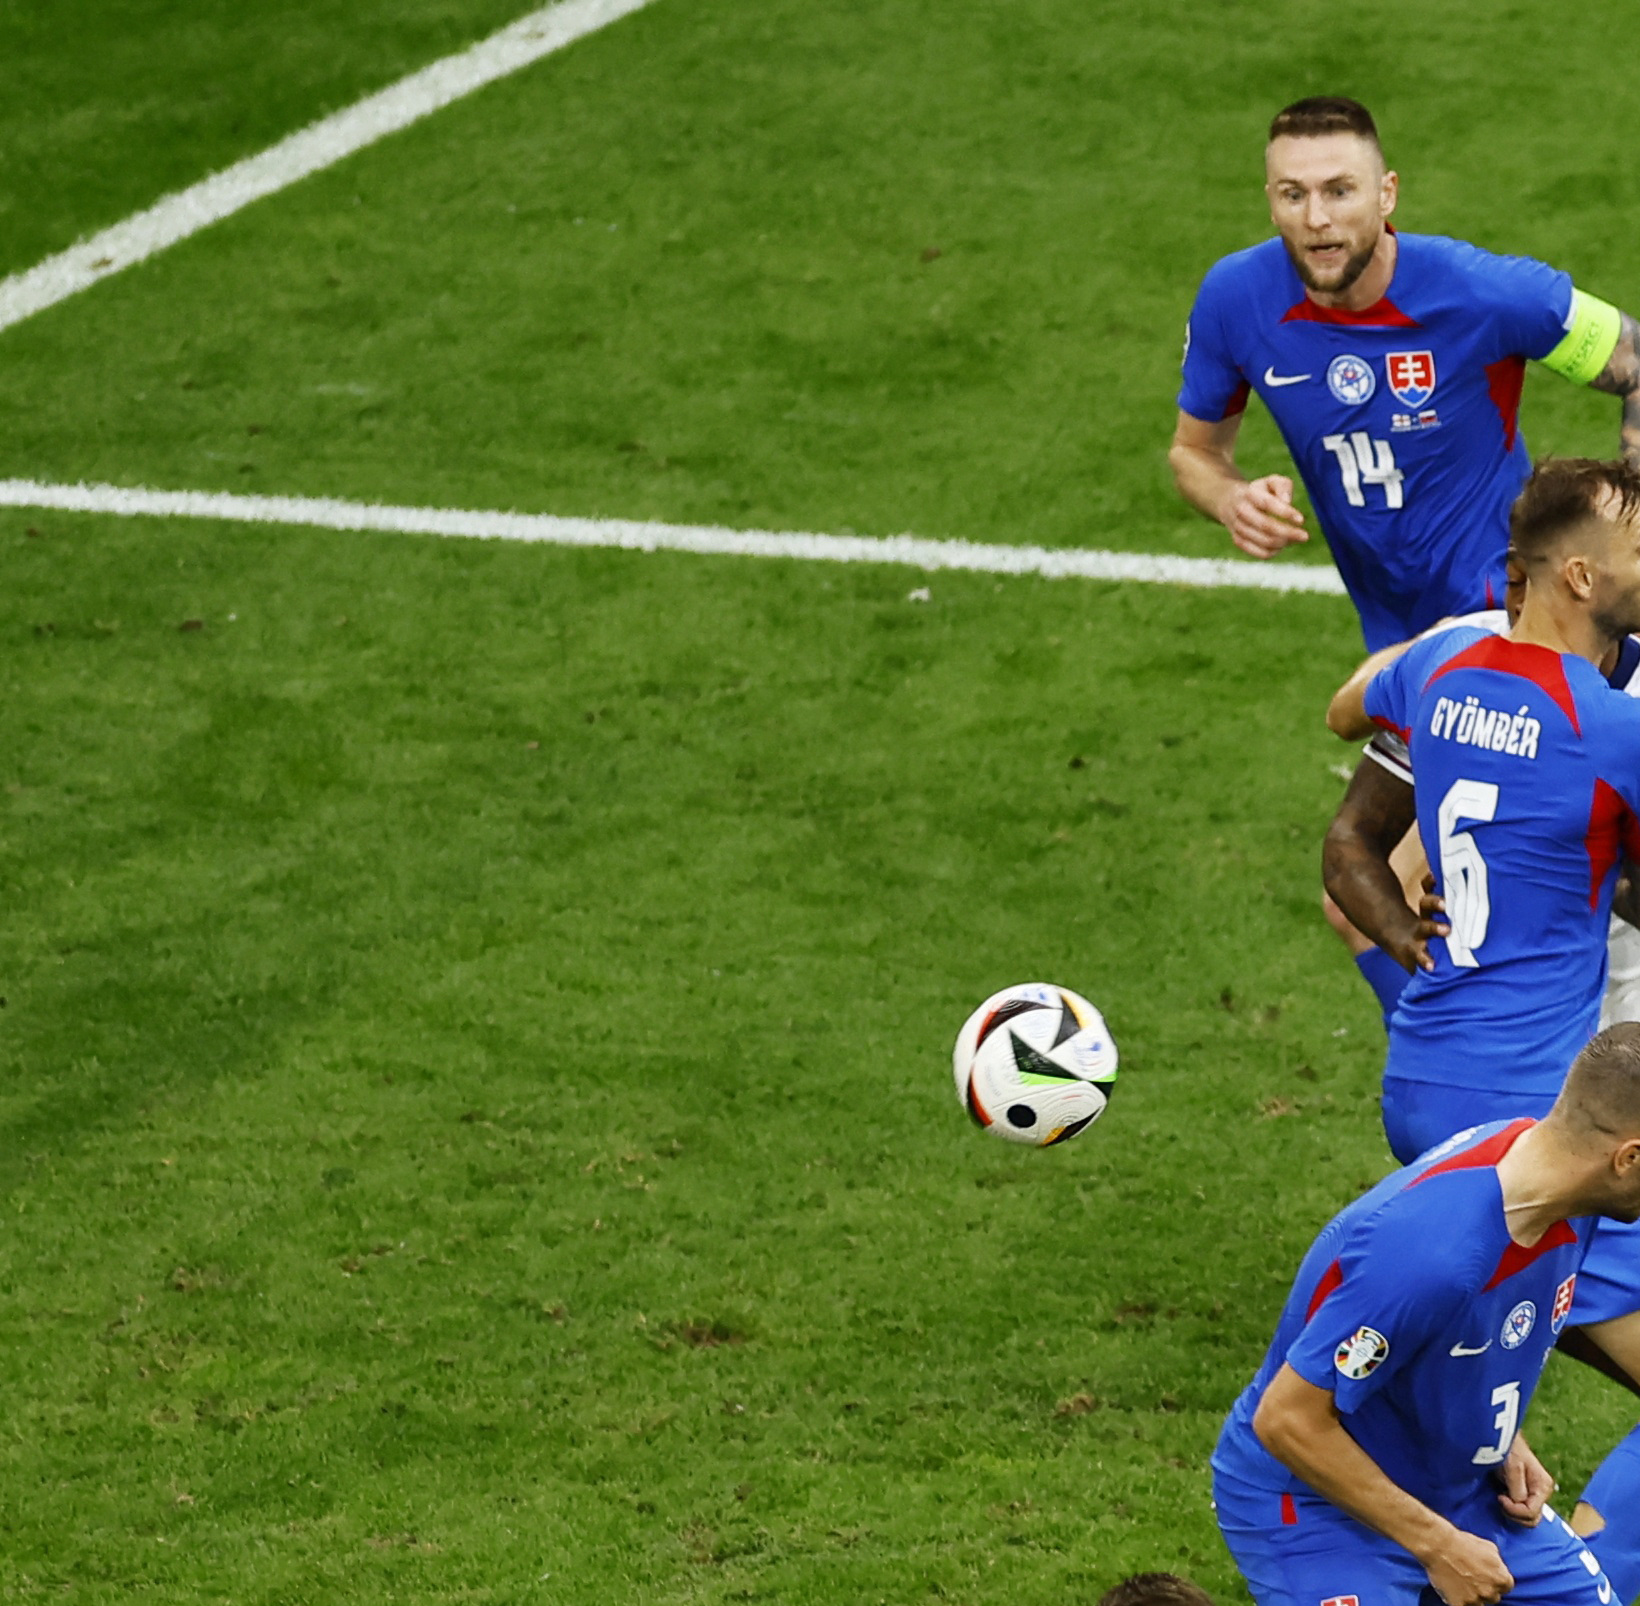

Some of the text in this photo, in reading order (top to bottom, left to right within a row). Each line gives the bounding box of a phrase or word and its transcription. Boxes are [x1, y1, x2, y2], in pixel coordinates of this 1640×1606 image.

[1322, 431, 1404, 509] 14
[1430, 695, 1541, 760] GYÖMBÉR
[1438, 778, 1499, 968] 6
[1471, 1381, 1520, 1465] 3
